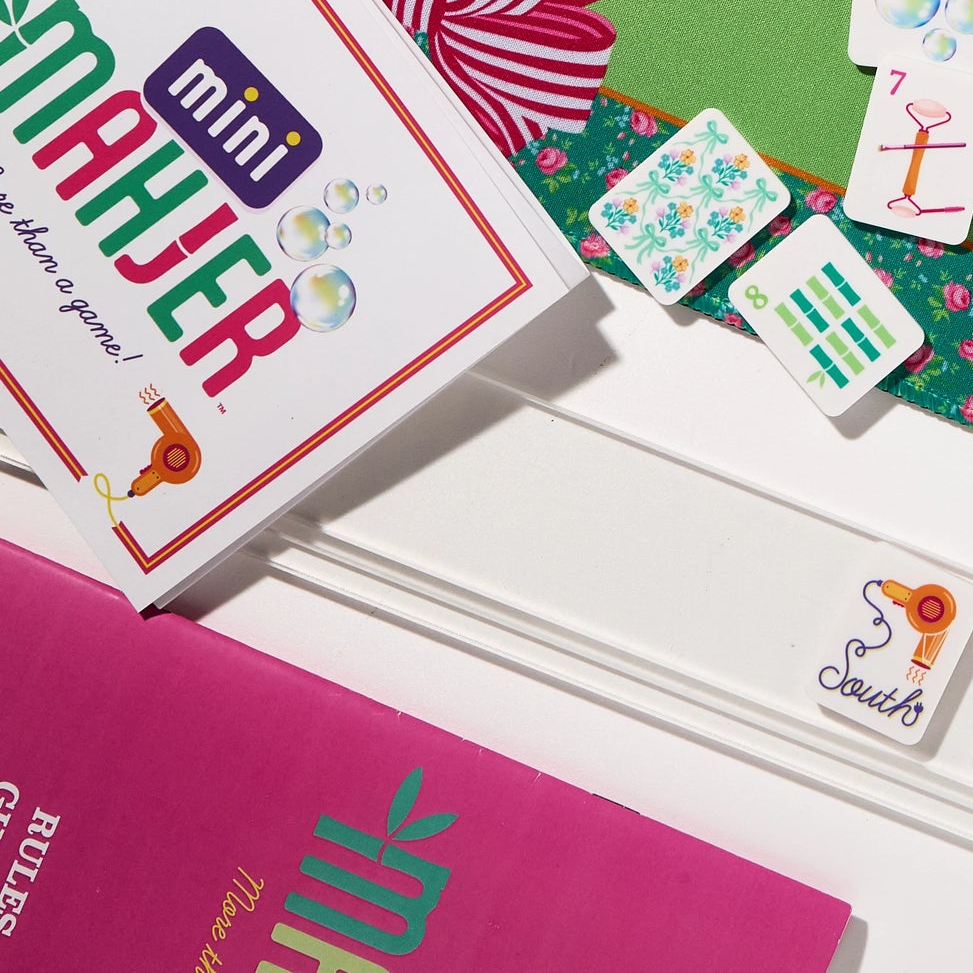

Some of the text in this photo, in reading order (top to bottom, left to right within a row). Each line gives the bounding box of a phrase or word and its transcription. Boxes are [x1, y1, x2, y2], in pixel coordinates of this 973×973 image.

[889, 69, 907, 95] 7
[167, 58, 301, 182] mini
[9, 218, 59, 274] than
[55, 278, 74, 294] a
[744, 284, 769, 310] 8
[58, 299, 144, 364] game!
[819, 638, 924, 726] South
[0, 806, 61, 937] RULES
[212, 867, 264, 941] More
